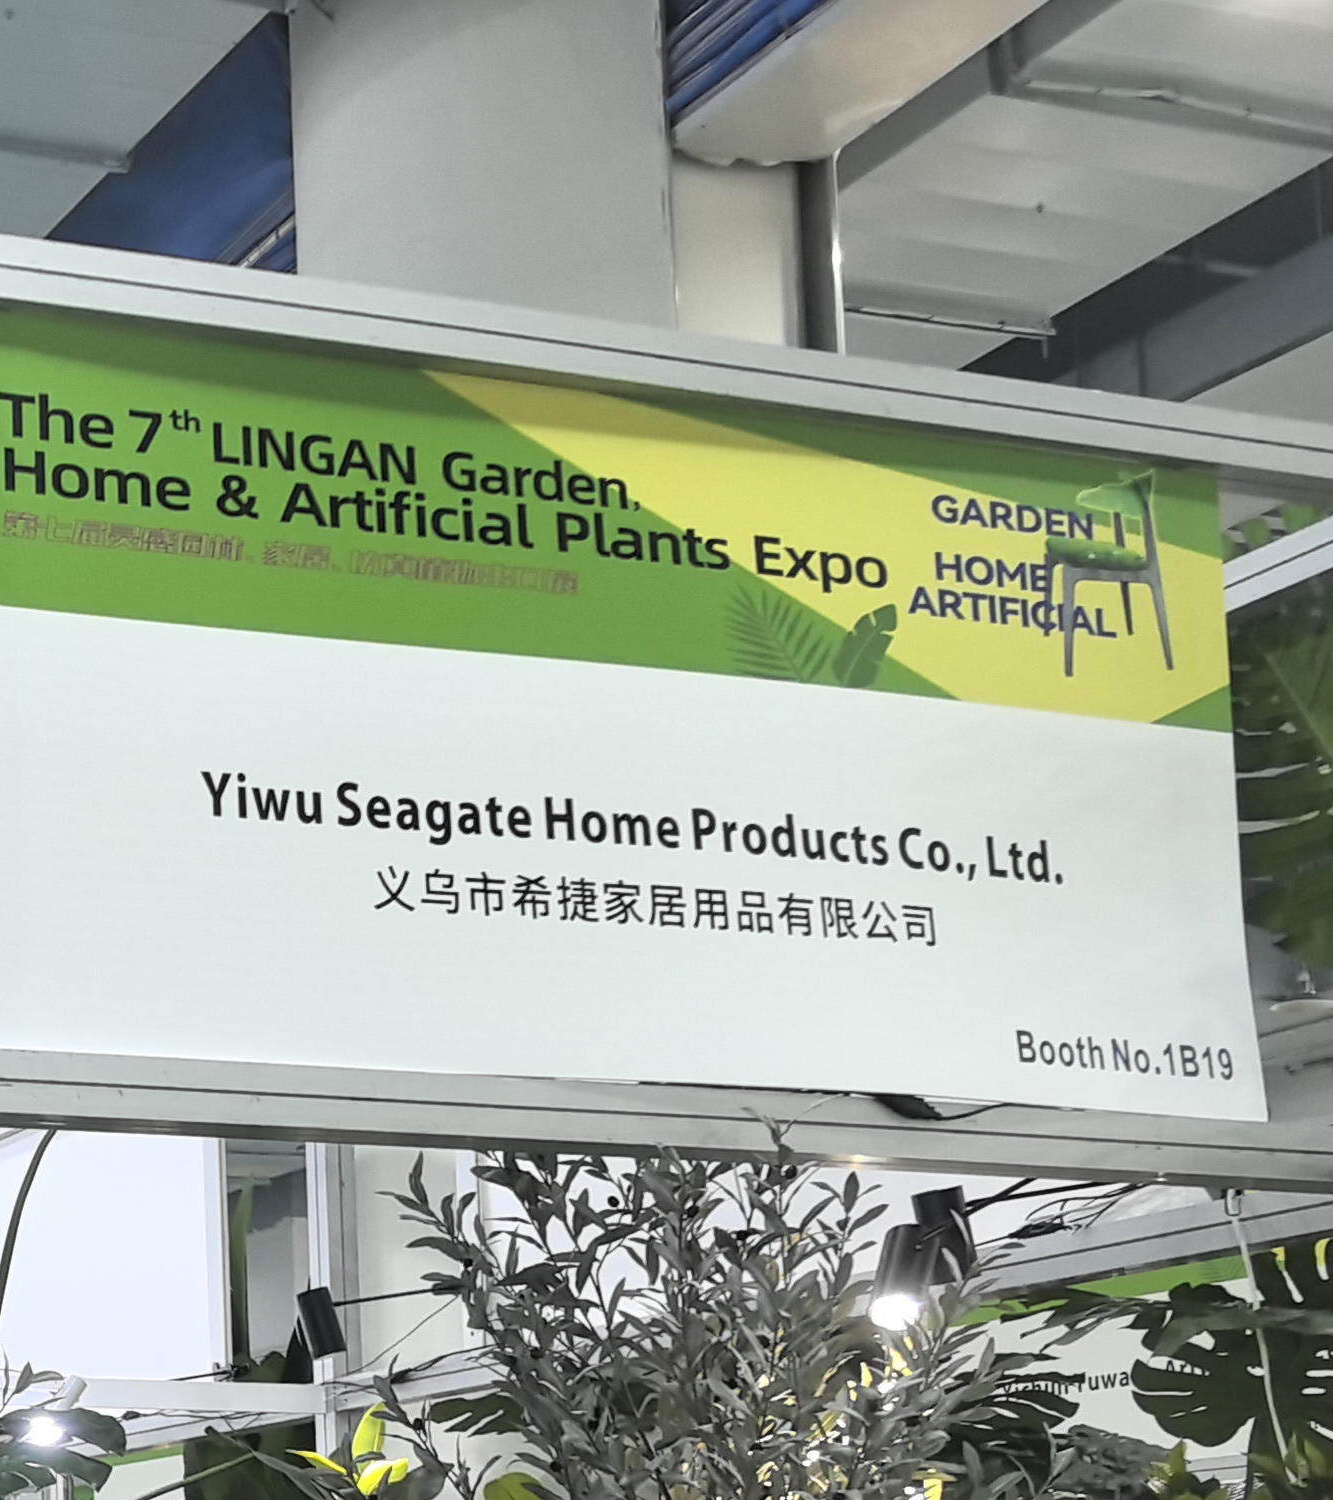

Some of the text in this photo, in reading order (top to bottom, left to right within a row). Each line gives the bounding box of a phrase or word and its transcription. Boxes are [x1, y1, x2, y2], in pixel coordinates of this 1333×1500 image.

[128, 410, 201, 453] 7th
[212, 422, 418, 485] LINGAN
[442, 451, 641, 512] Garden,
[3, 447, 888, 593] Home & Artificial Plants Expo
[931, 495, 1095, 540] GARDEN
[934, 551, 1051, 593] HOME
[908, 588, 1118, 639] ARTIFICIAL
[200, 770, 1065, 885] Yiwu Seagate Home Products Co., Ltd.
[373, 865, 937, 948] 义乌市希捷家居用品有限公司
[1016, 1030, 1234, 1082] Booth No.1B19
